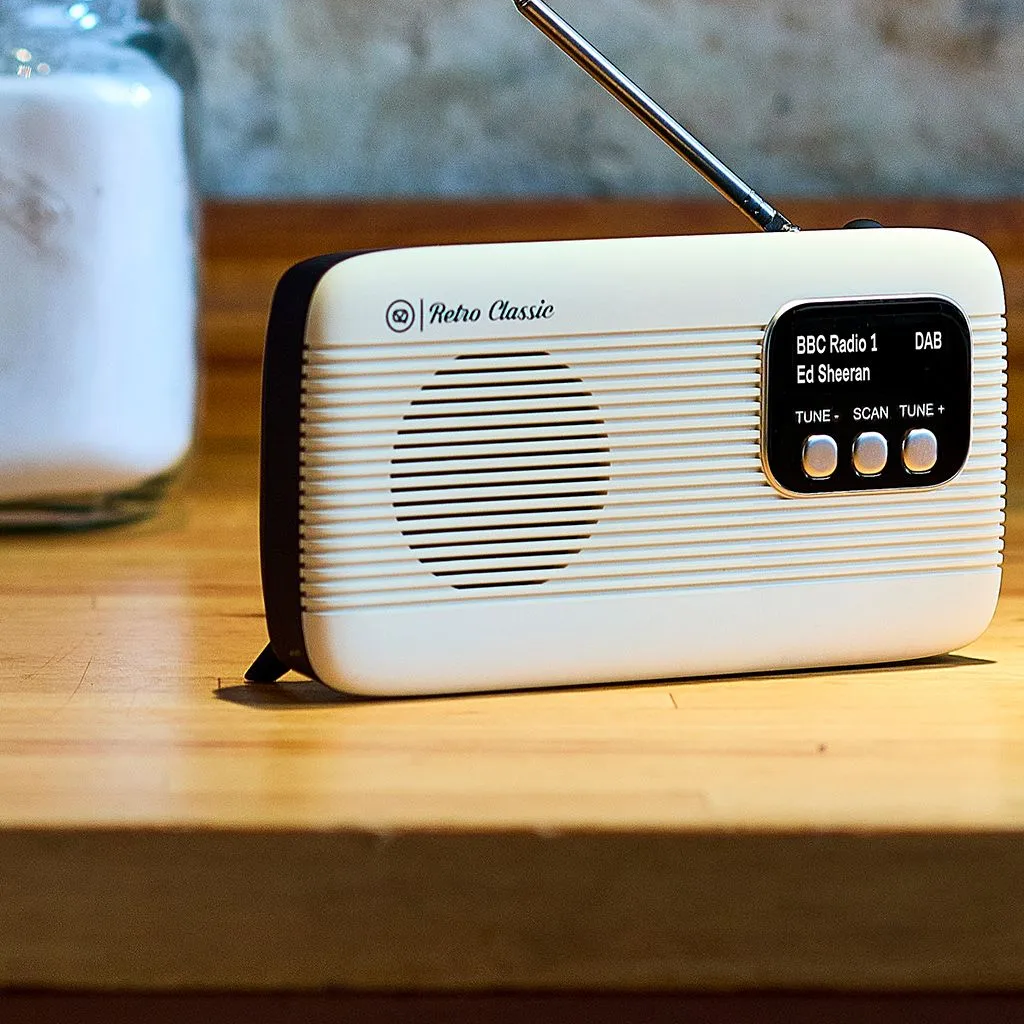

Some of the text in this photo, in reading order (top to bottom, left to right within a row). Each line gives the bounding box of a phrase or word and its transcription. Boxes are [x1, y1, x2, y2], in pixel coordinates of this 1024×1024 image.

[429, 299, 555, 324] Retro Classic
[796, 333, 878, 354] BBC Radio 1
[915, 331, 942, 350] DAB
[797, 364, 871, 384] Ed Sheeran
[853, 406, 889, 420] SCAN
[899, 403, 934, 417] TUNE
